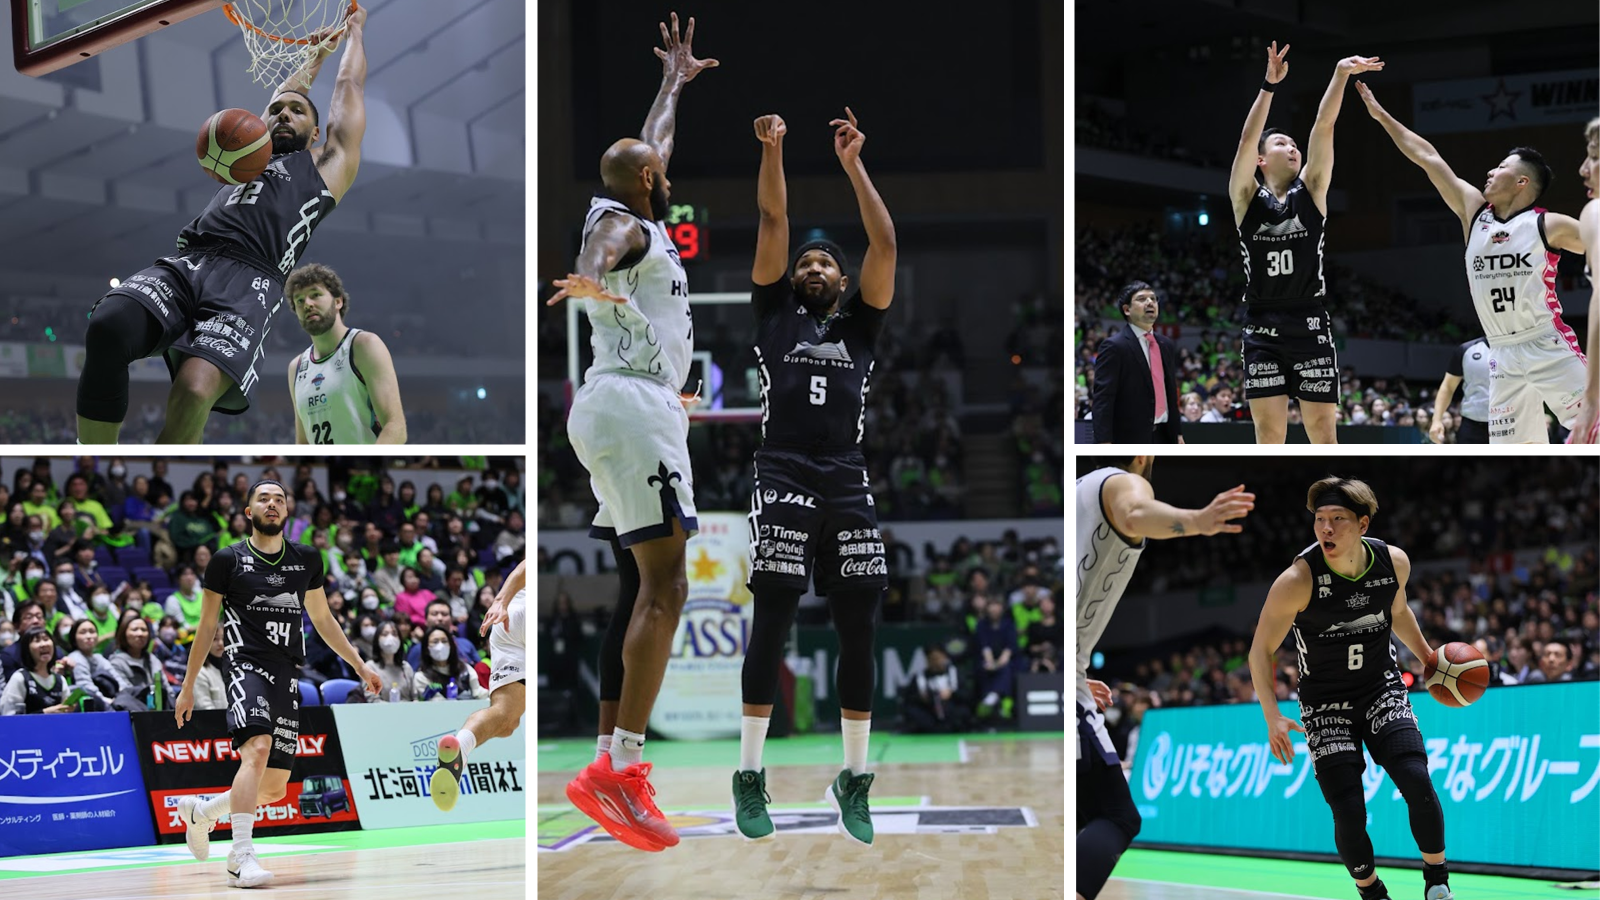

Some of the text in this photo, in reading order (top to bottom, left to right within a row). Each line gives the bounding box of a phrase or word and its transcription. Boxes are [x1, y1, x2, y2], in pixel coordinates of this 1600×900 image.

[225, 181, 264, 207] 22
[1253, 234, 1287, 242] Diamond
[1267, 249, 1294, 277] 30
[1484, 253, 1533, 270] TDK
[1490, 286, 1515, 313] 24
[1255, 326, 1279, 337] JAL
[1306, 317, 1321, 331] 30
[784, 355, 854, 370] Diamond head
[809, 375, 827, 406] 5
[308, 393, 327, 407] RFG
[312, 421, 334, 445] 22
[779, 492, 816, 509] JAL
[772, 525, 809, 542] Timee
[776, 542, 804, 556] Ohfuji
[246, 605, 285, 614] Diamond
[265, 621, 291, 647] 34
[1348, 644, 1364, 671] 6
[254, 667, 275, 685] JAL
[1316, 701, 1353, 713] JAL
[153, 741, 211, 762] NEW
